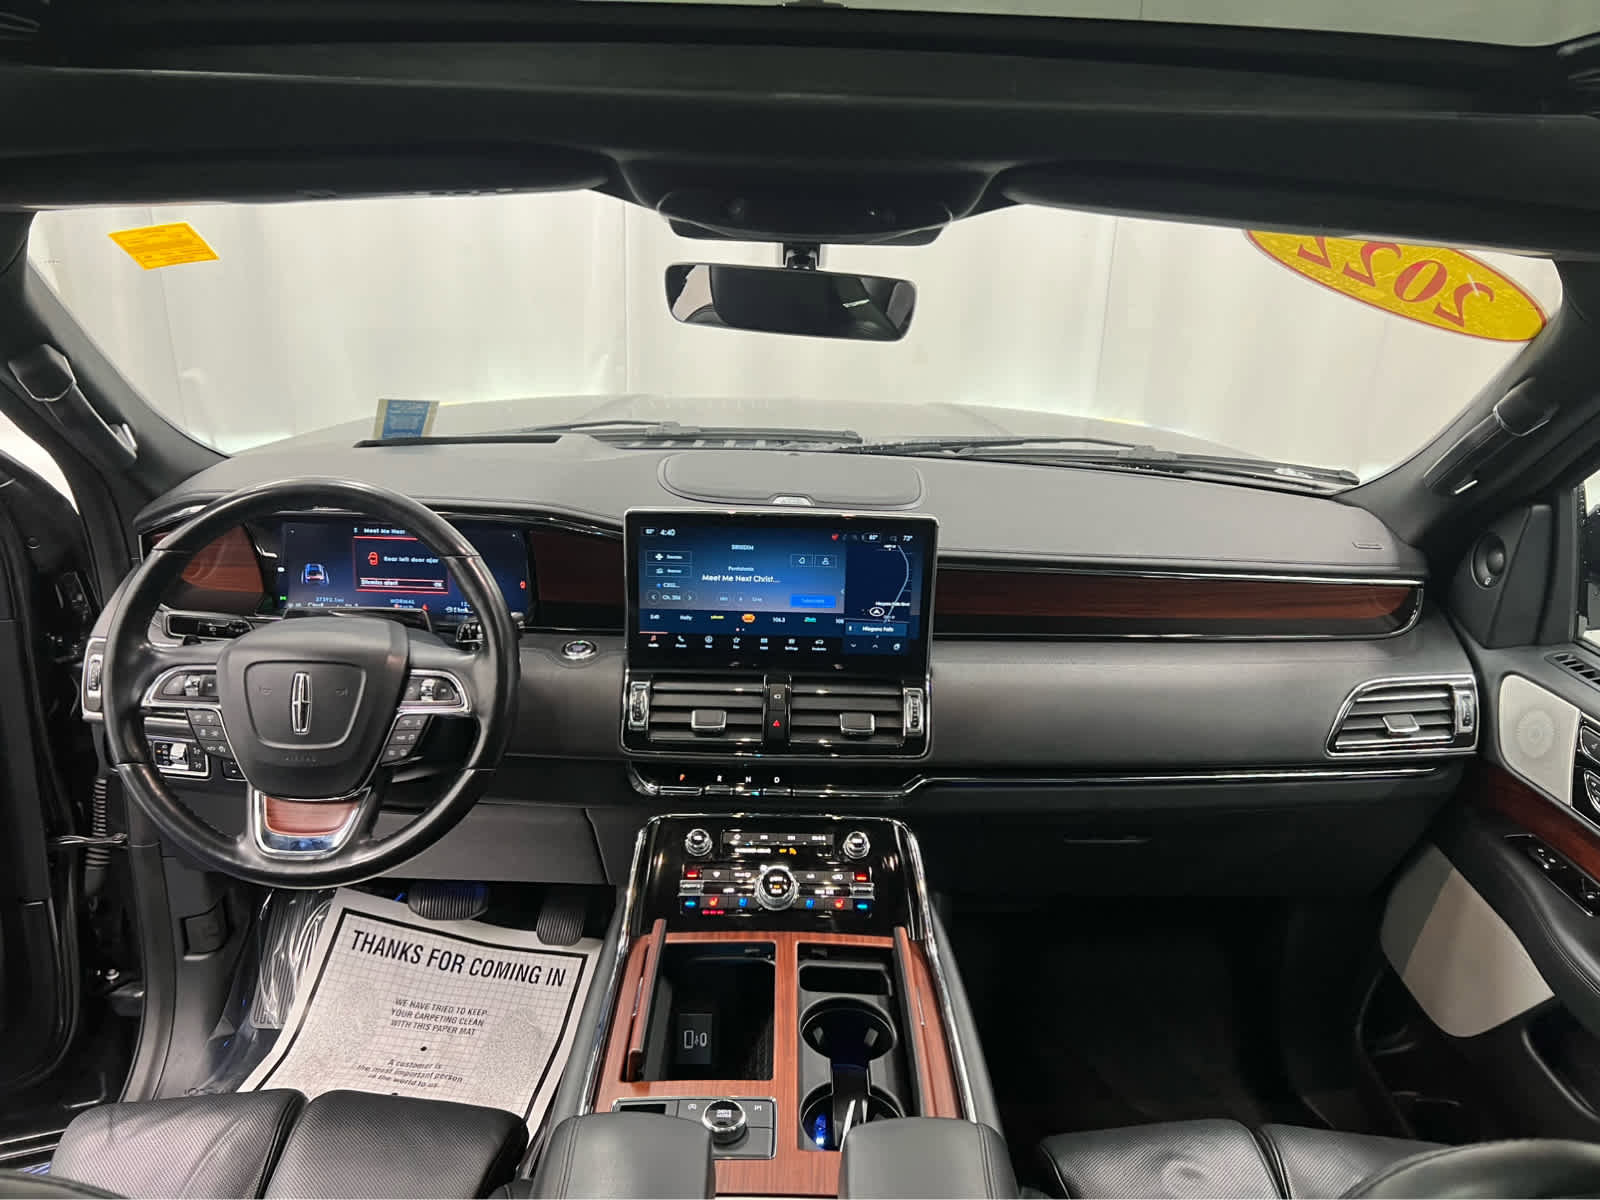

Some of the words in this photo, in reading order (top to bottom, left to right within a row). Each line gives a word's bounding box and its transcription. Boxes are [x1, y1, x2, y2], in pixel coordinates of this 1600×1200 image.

[351, 930, 424, 964] THANKS
[426, 948, 466, 974] FOR
[468, 958, 543, 985] COMING
[545, 967, 567, 987] IN
[391, 1007, 413, 1017] YOUR
[414, 1011, 458, 1025] CARPETING
[459, 1018, 485, 1027] CLEAN
[409, 1000, 431, 1011] HAVE
[432, 1003, 454, 1014] TRIED
[456, 1006, 466, 1015] TO
[467, 1008, 488, 1017] KEEP
[390, 1019, 411, 1028] WITH
[413, 1021, 432, 1031] THIS
[432, 1024, 458, 1034] PAPER
[458, 1027, 476, 1036] MAT
[357, 1064, 371, 1072] the
[371, 1066, 393, 1074] most
[393, 1068, 434, 1079] important
[433, 1072, 464, 1083] person
[395, 1060, 433, 1070] customer
